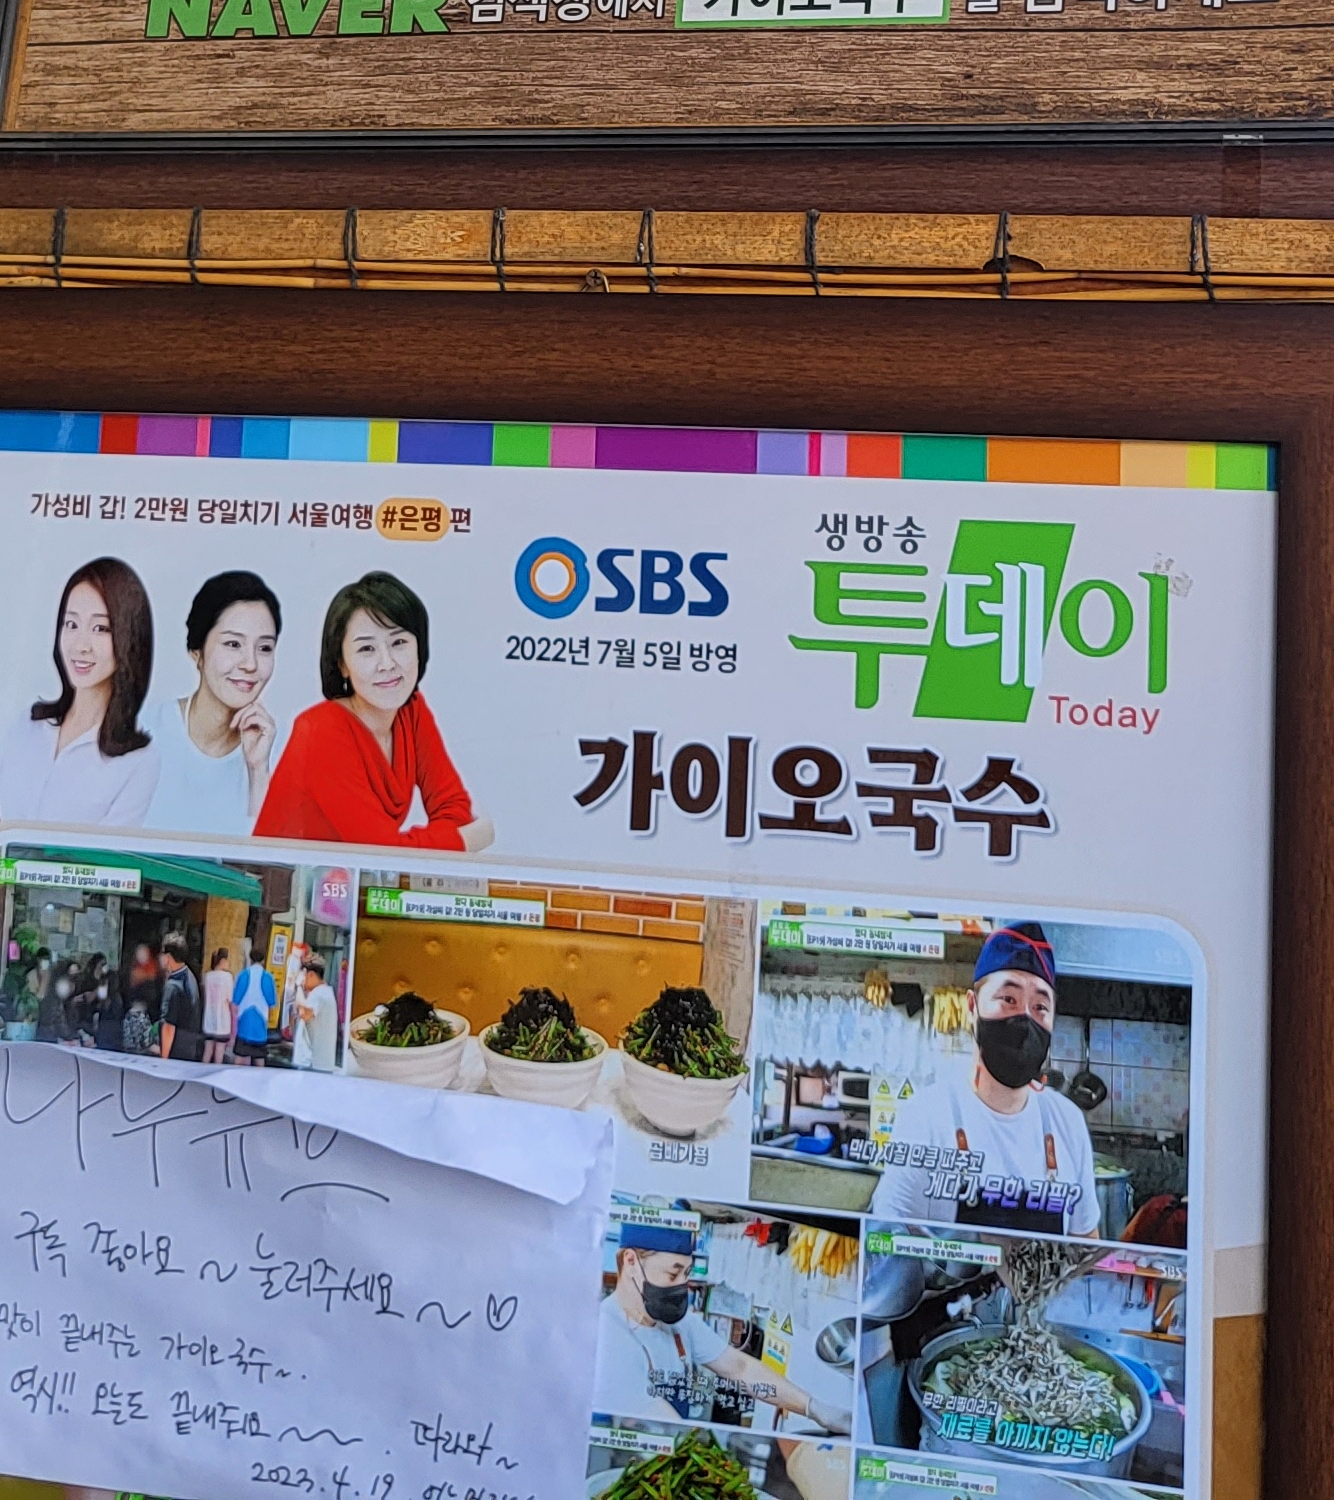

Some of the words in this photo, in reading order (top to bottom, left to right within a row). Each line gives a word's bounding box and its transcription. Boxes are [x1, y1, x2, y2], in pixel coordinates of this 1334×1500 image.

[29, 491, 92, 520] 가성비
[97, 494, 128, 521] 갑!
[133, 495, 191, 524] 2만원
[196, 497, 281, 528] 당일치기
[286, 501, 374, 532] 서울여행
[381, 503, 446, 534] #은평
[448, 506, 473, 534] 편
[813, 511, 928, 556] 생방송
[594, 546, 730, 618] SBS
[504, 634, 591, 668] 2022년
[596, 637, 638, 669] 7월
[643, 639, 682, 671] 5일
[688, 640, 739, 675] 방영
[786, 556, 1171, 712] 투데이
[1048, 694, 1161, 735] Today
[572, 727, 1053, 860] 가이오국수
[848, 1138, 879, 1162] 먹다
[878, 1141, 910, 1165] 지칠
[909, 1145, 940, 1169] 만큼
[939, 1148, 985, 1173] 퍼주고
[924, 1170, 981, 1202] 게다가
[981, 1175, 1023, 1208] 무한
[1025, 1181, 1083, 1214] 리필?
[936, 1411, 992, 1445] 재료를
[994, 1420, 1051, 1453] 아끼지
[1052, 1429, 1116, 1462] 않는다!
